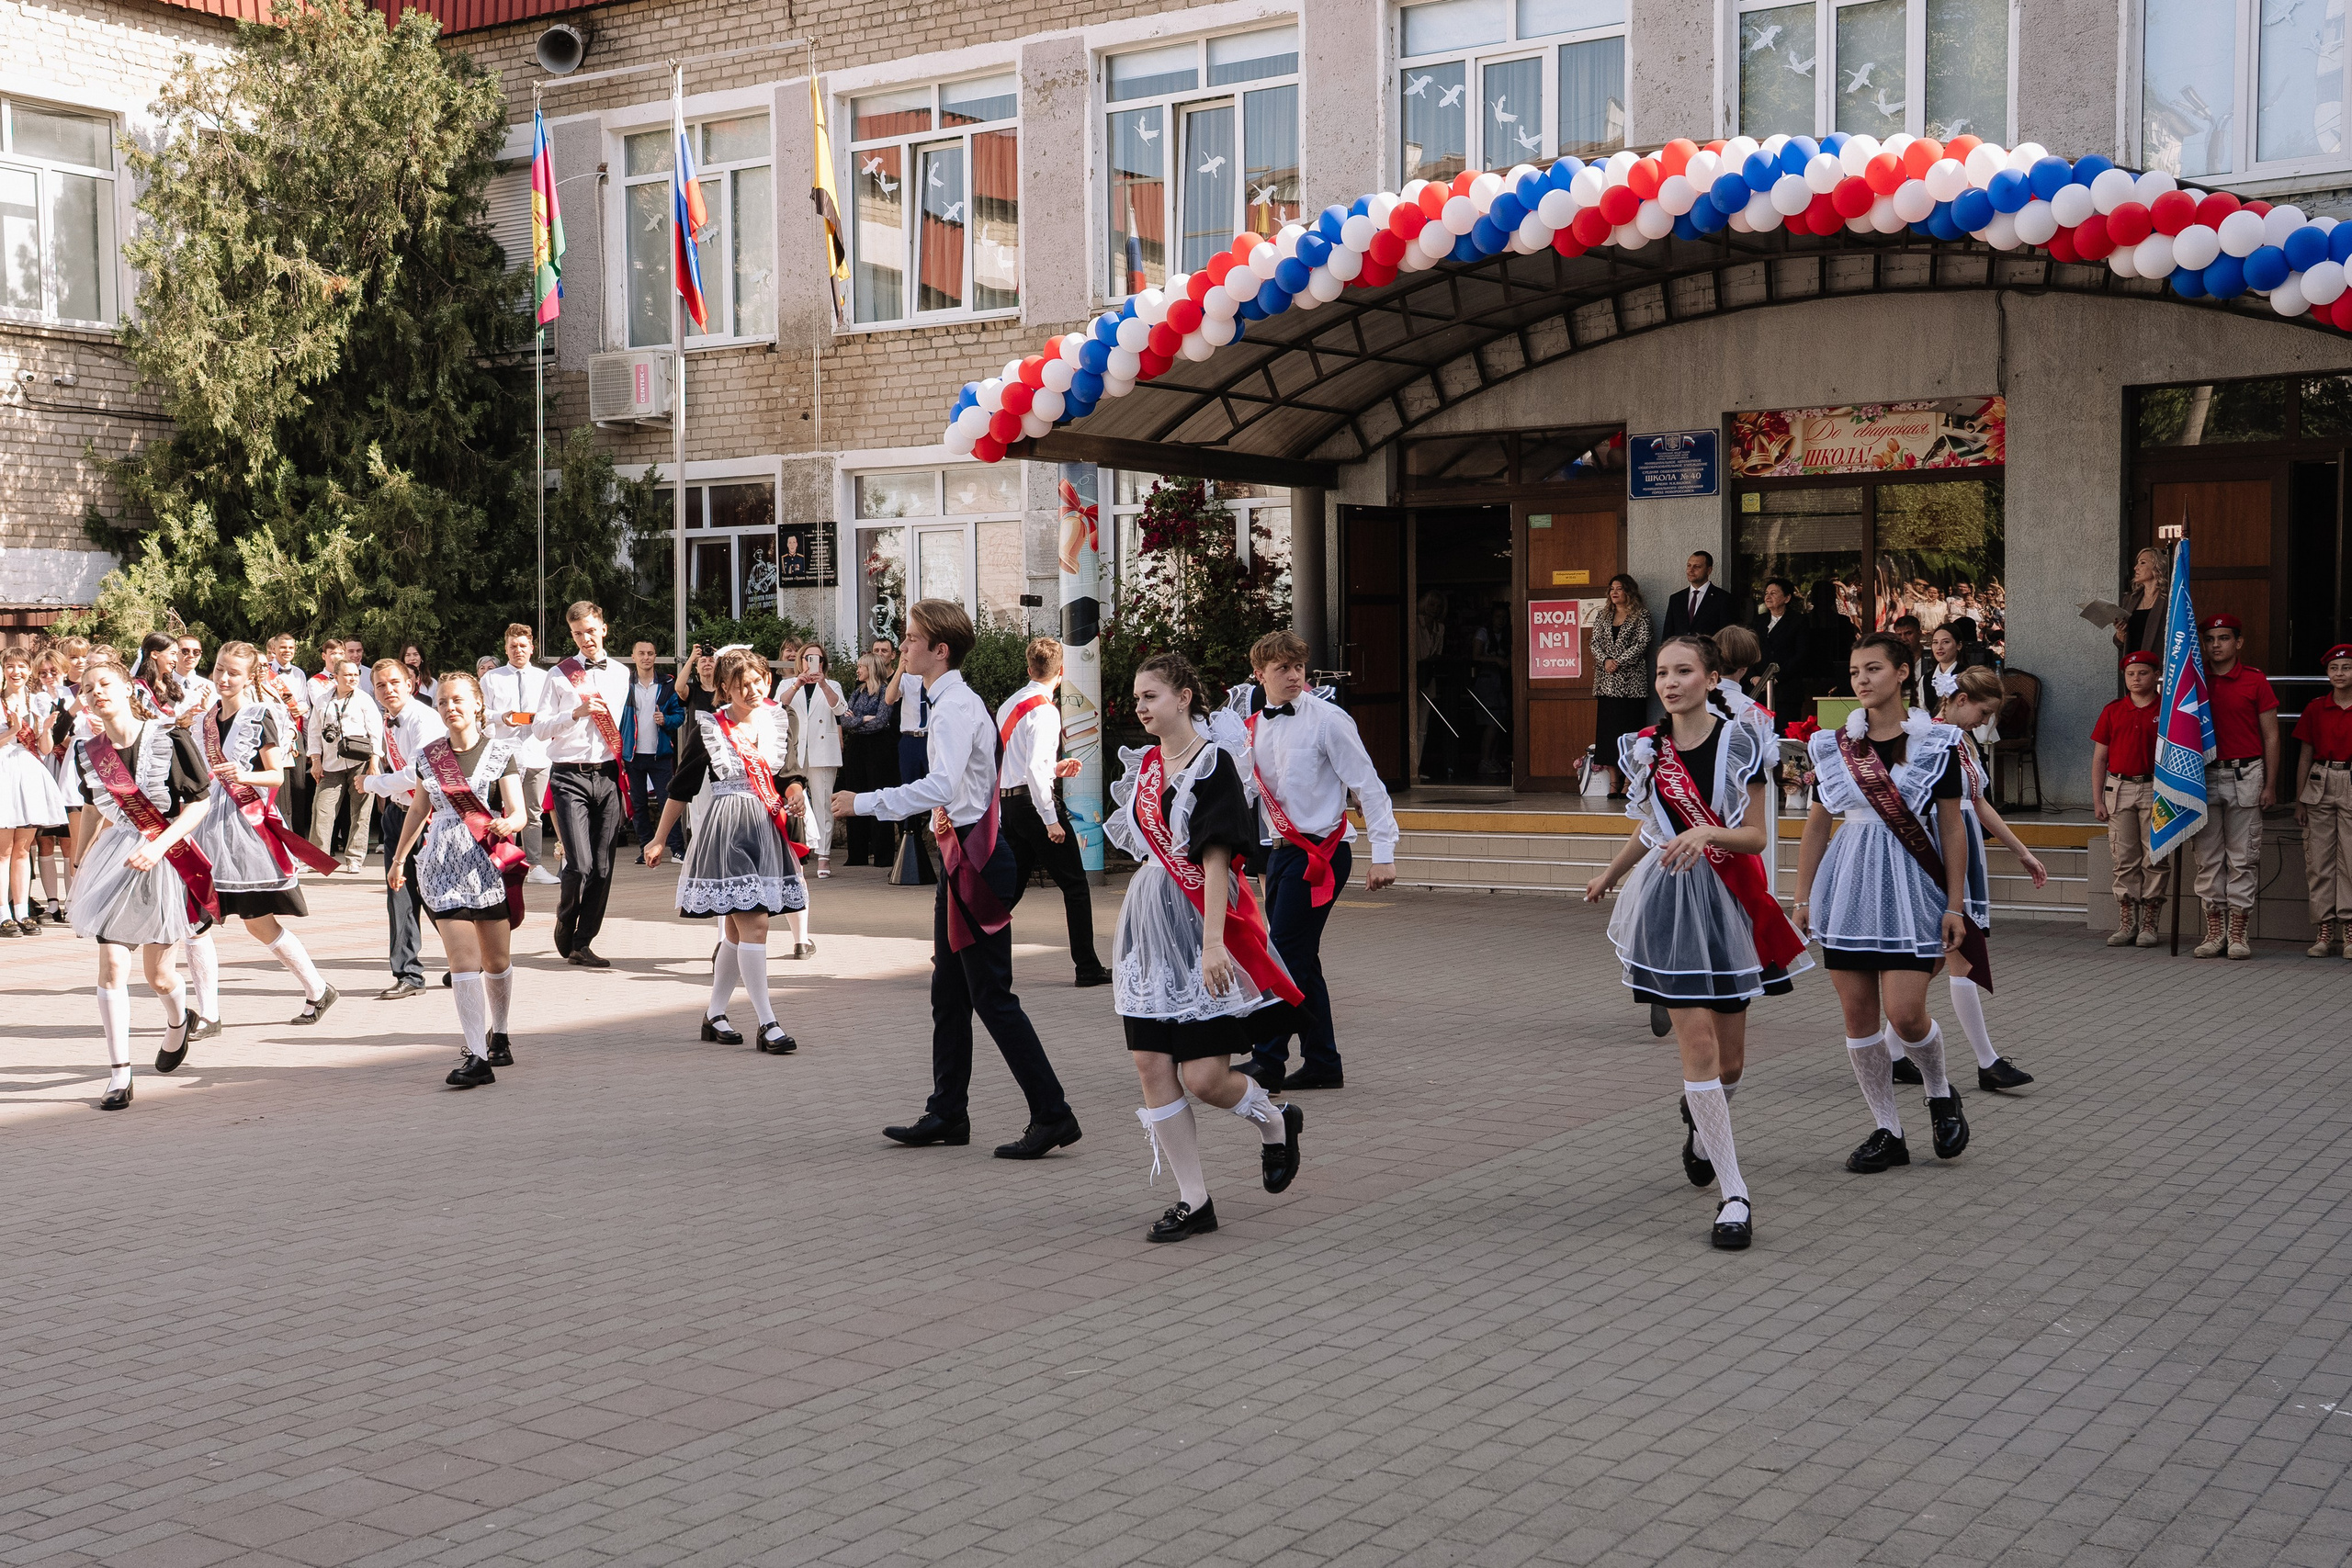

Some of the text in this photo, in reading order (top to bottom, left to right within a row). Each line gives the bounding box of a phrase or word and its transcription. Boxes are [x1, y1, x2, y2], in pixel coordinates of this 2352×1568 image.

[1804, 418, 1931, 446] До свидания,
[1803, 446, 1872, 468] ШКОЛА!
[1645, 474, 1677, 482] ШКОЛА
[1533, 610, 1577, 626] ВХОД
[1539, 631, 1569, 649] №1
[2171, 631, 2186, 660] №40
[1535, 658, 1577, 668] 1 этаж
[1655, 761, 1710, 828] Выпускниц
[1271, 810, 1293, 832] 2025
[1177, 864, 1205, 890] 2025
